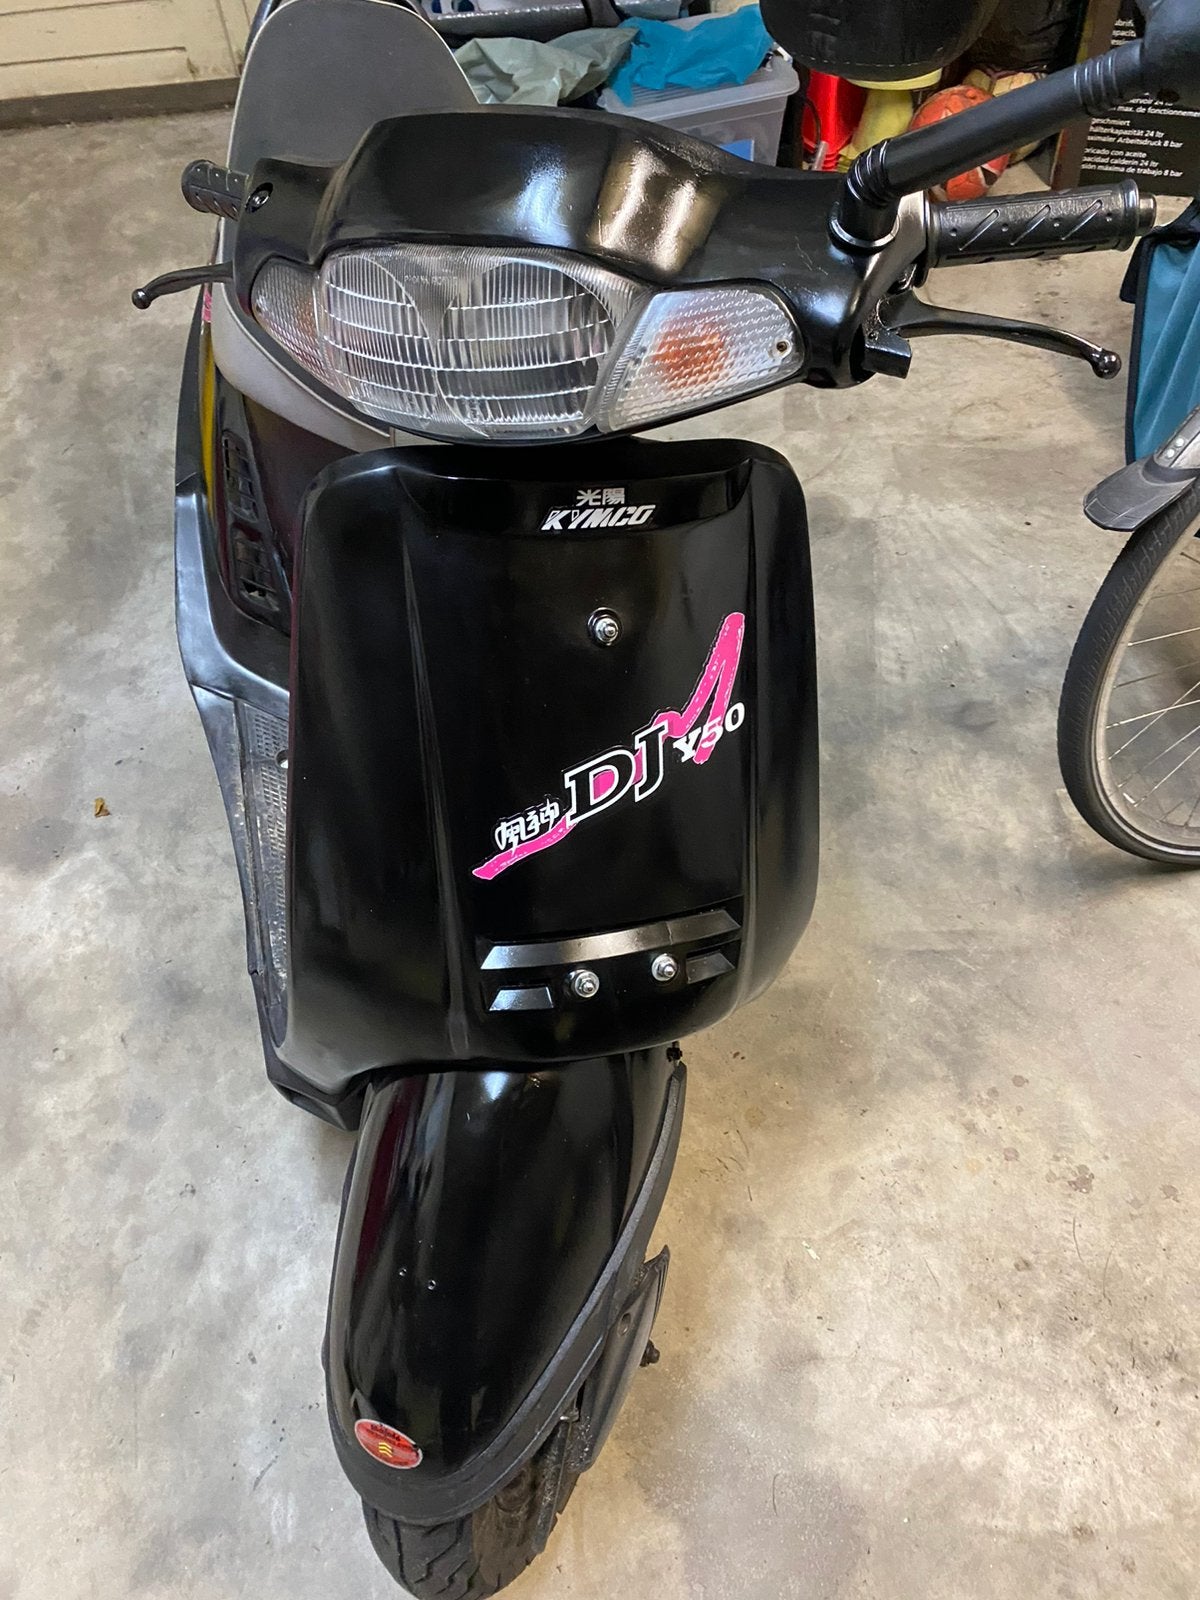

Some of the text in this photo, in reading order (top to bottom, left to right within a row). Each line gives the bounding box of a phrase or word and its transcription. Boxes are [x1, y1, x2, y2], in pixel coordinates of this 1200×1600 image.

[1170, 140, 1184, 148] bar
[1125, 150, 1147, 158] aceite
[1136, 167, 1163, 177] trabajo
[1169, 169, 1183, 177] bar
[576, 487, 625, 506] 光陽
[541, 504, 656, 531] KYMCO
